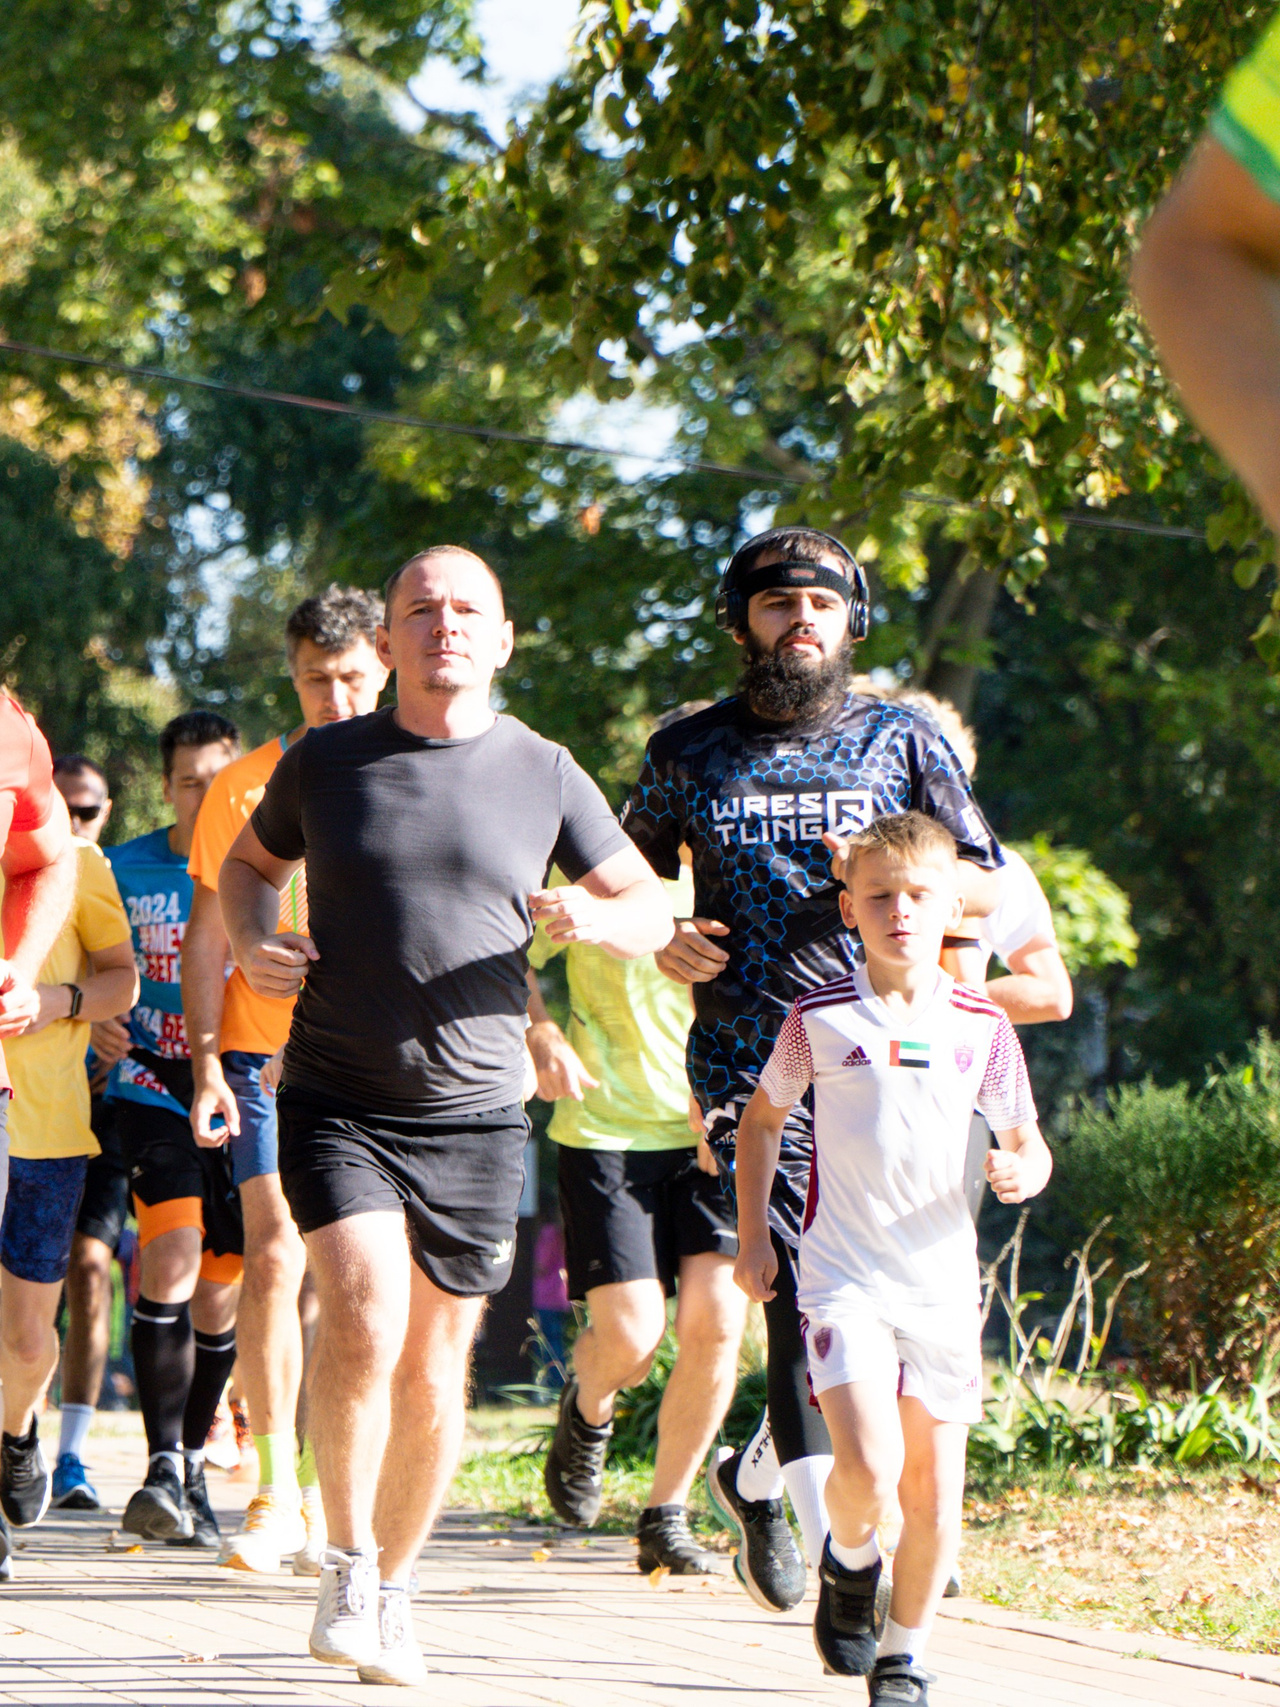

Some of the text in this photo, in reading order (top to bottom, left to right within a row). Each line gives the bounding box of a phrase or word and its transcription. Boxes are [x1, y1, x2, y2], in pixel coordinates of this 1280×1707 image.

[711, 793, 822, 821] WRES
[714, 817, 822, 846] TLING
[126, 891, 181, 926] 2024
[842, 1059, 871, 1067] adidas
